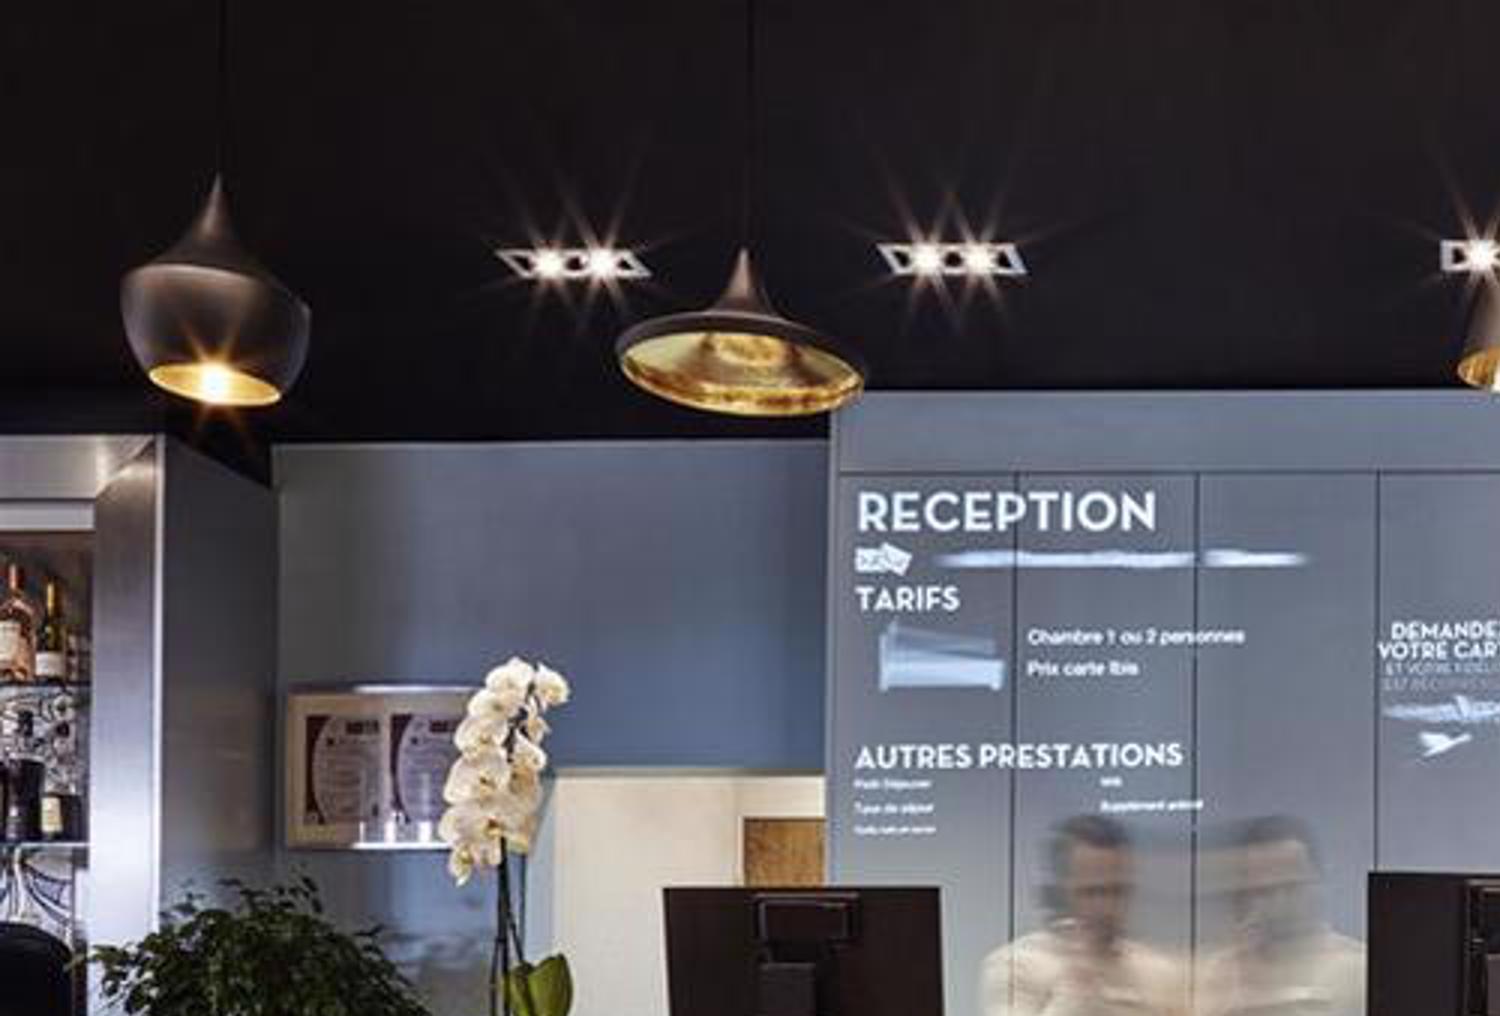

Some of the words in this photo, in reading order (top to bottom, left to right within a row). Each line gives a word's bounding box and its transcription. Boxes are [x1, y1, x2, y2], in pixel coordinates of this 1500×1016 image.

[857, 490, 1157, 533] RECEPTION
[854, 585, 961, 613] TARIFS
[1027, 628, 1104, 646] Chambre
[1106, 628, 1116, 646] 1
[1119, 630, 1143, 646] ou
[1146, 627, 1158, 646] 2
[1160, 630, 1246, 648] personnes
[1378, 640, 1449, 661] VOTRE
[1027, 658, 1060, 677] Prix
[1062, 660, 1105, 677] carte
[854, 743, 974, 769] AUTRES
[979, 741, 1184, 769] PRESTATIONS
